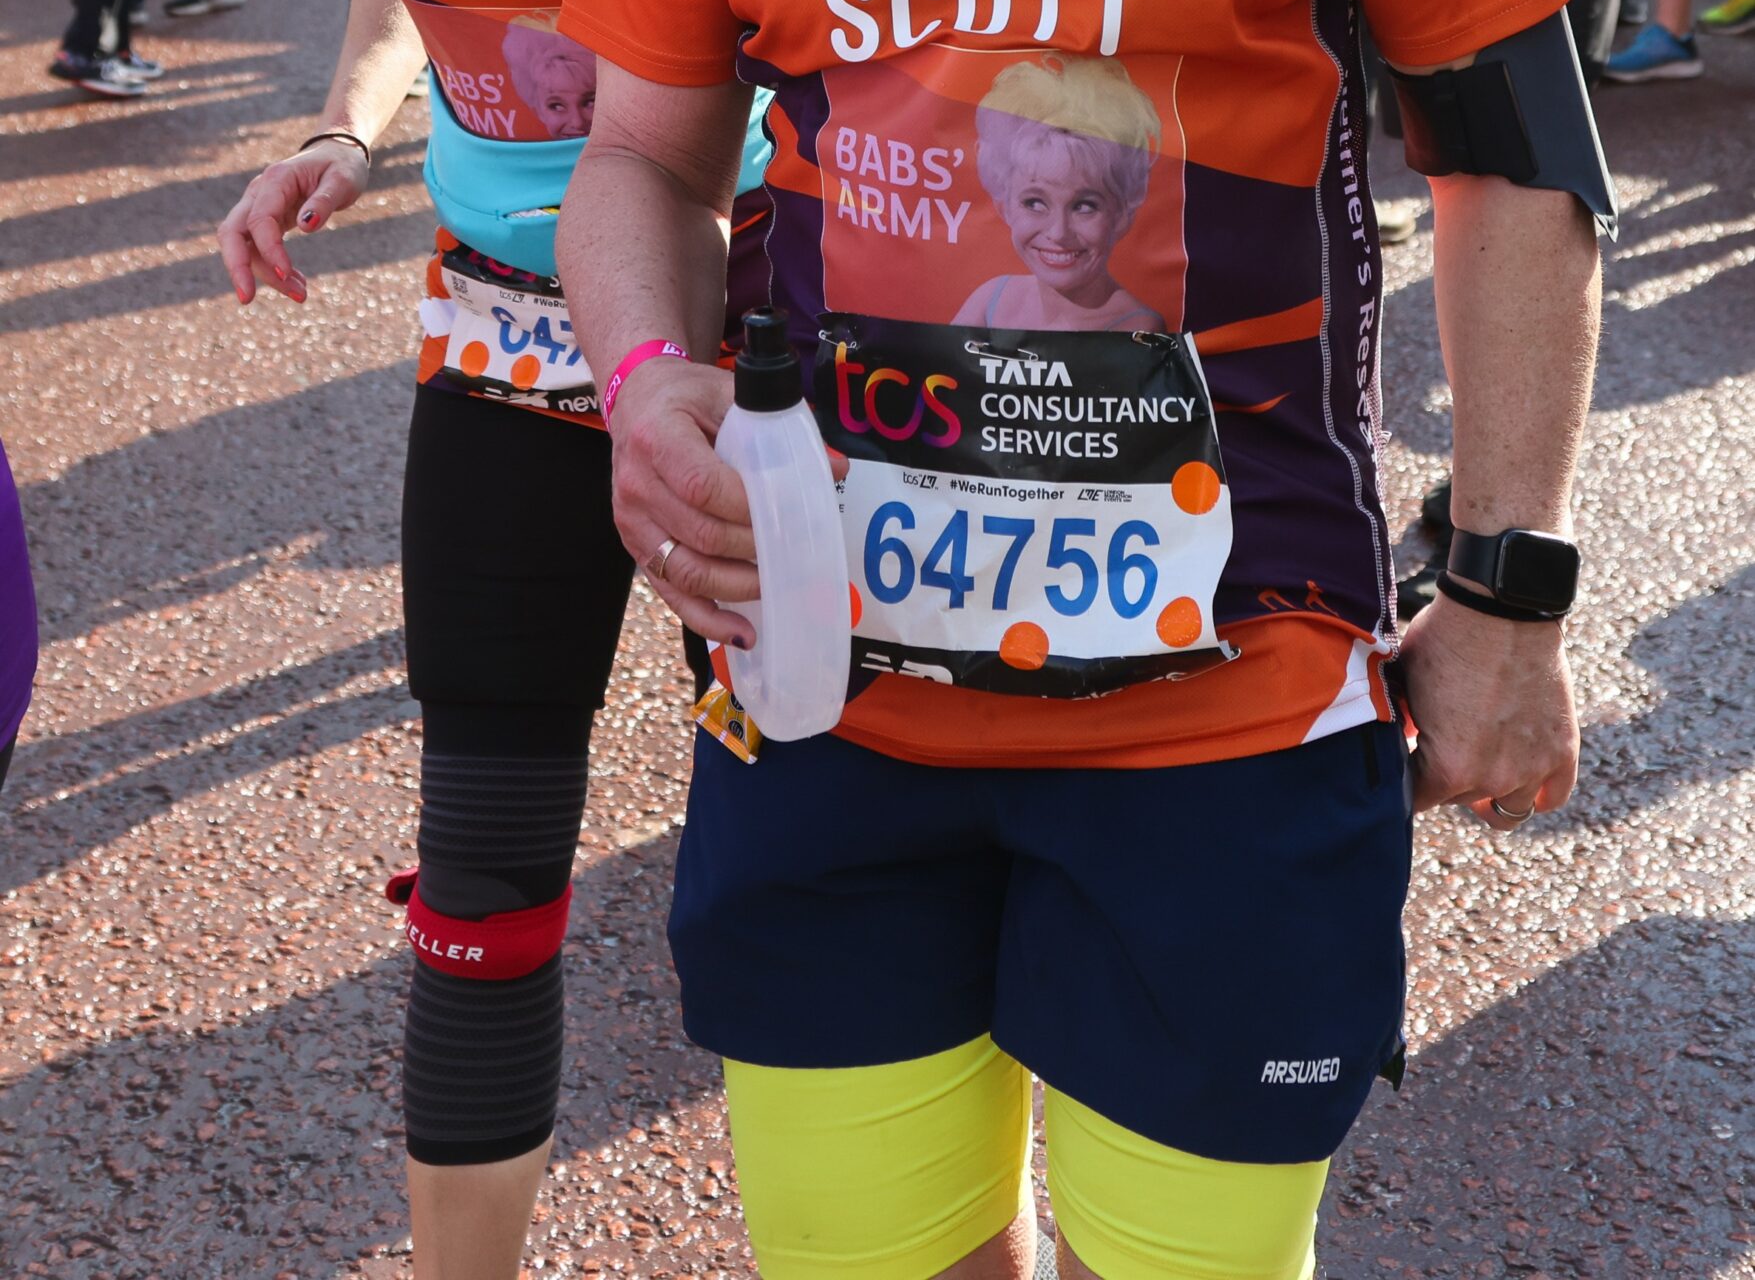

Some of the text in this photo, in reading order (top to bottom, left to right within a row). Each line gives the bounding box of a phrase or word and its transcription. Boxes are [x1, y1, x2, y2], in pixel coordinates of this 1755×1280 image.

[453, 99, 517, 138] RMY
[834, 126, 965, 192] BABS'
[836, 177, 972, 244] ARMY
[979, 357, 1073, 388] TATA
[834, 340, 961, 449] tcs
[980, 394, 1196, 424] CONSULTANCY
[981, 426, 1119, 459] SERVICES
[950, 479, 1065, 502] #WeRunTogether
[863, 500, 1160, 619] 64756
[1260, 1056, 1341, 1085] ARSUXED
